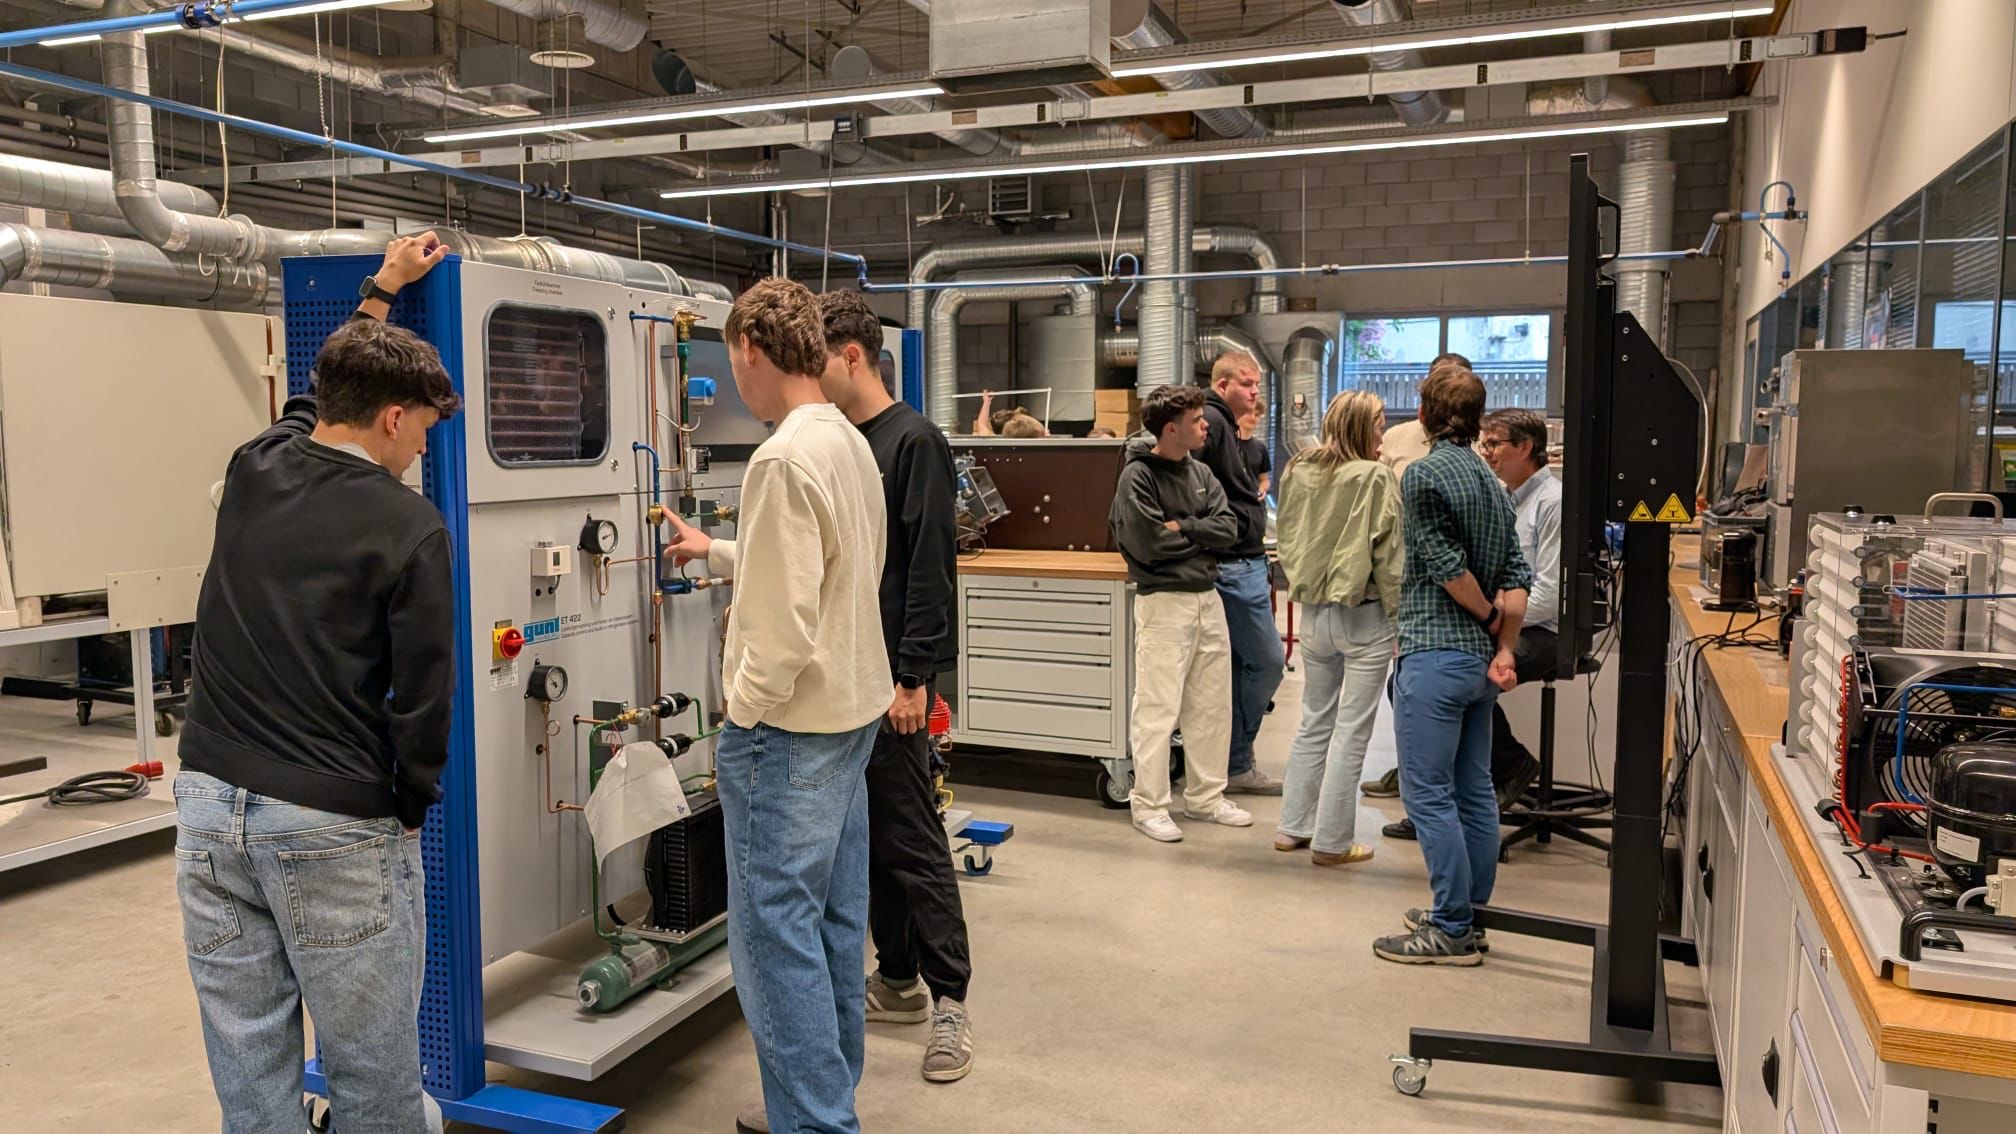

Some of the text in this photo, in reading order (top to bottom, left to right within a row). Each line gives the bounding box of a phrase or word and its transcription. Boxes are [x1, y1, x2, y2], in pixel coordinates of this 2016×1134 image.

[561, 616, 568, 625] ET
[570, 614, 582, 623] 422
[523, 617, 559, 643] gunt
